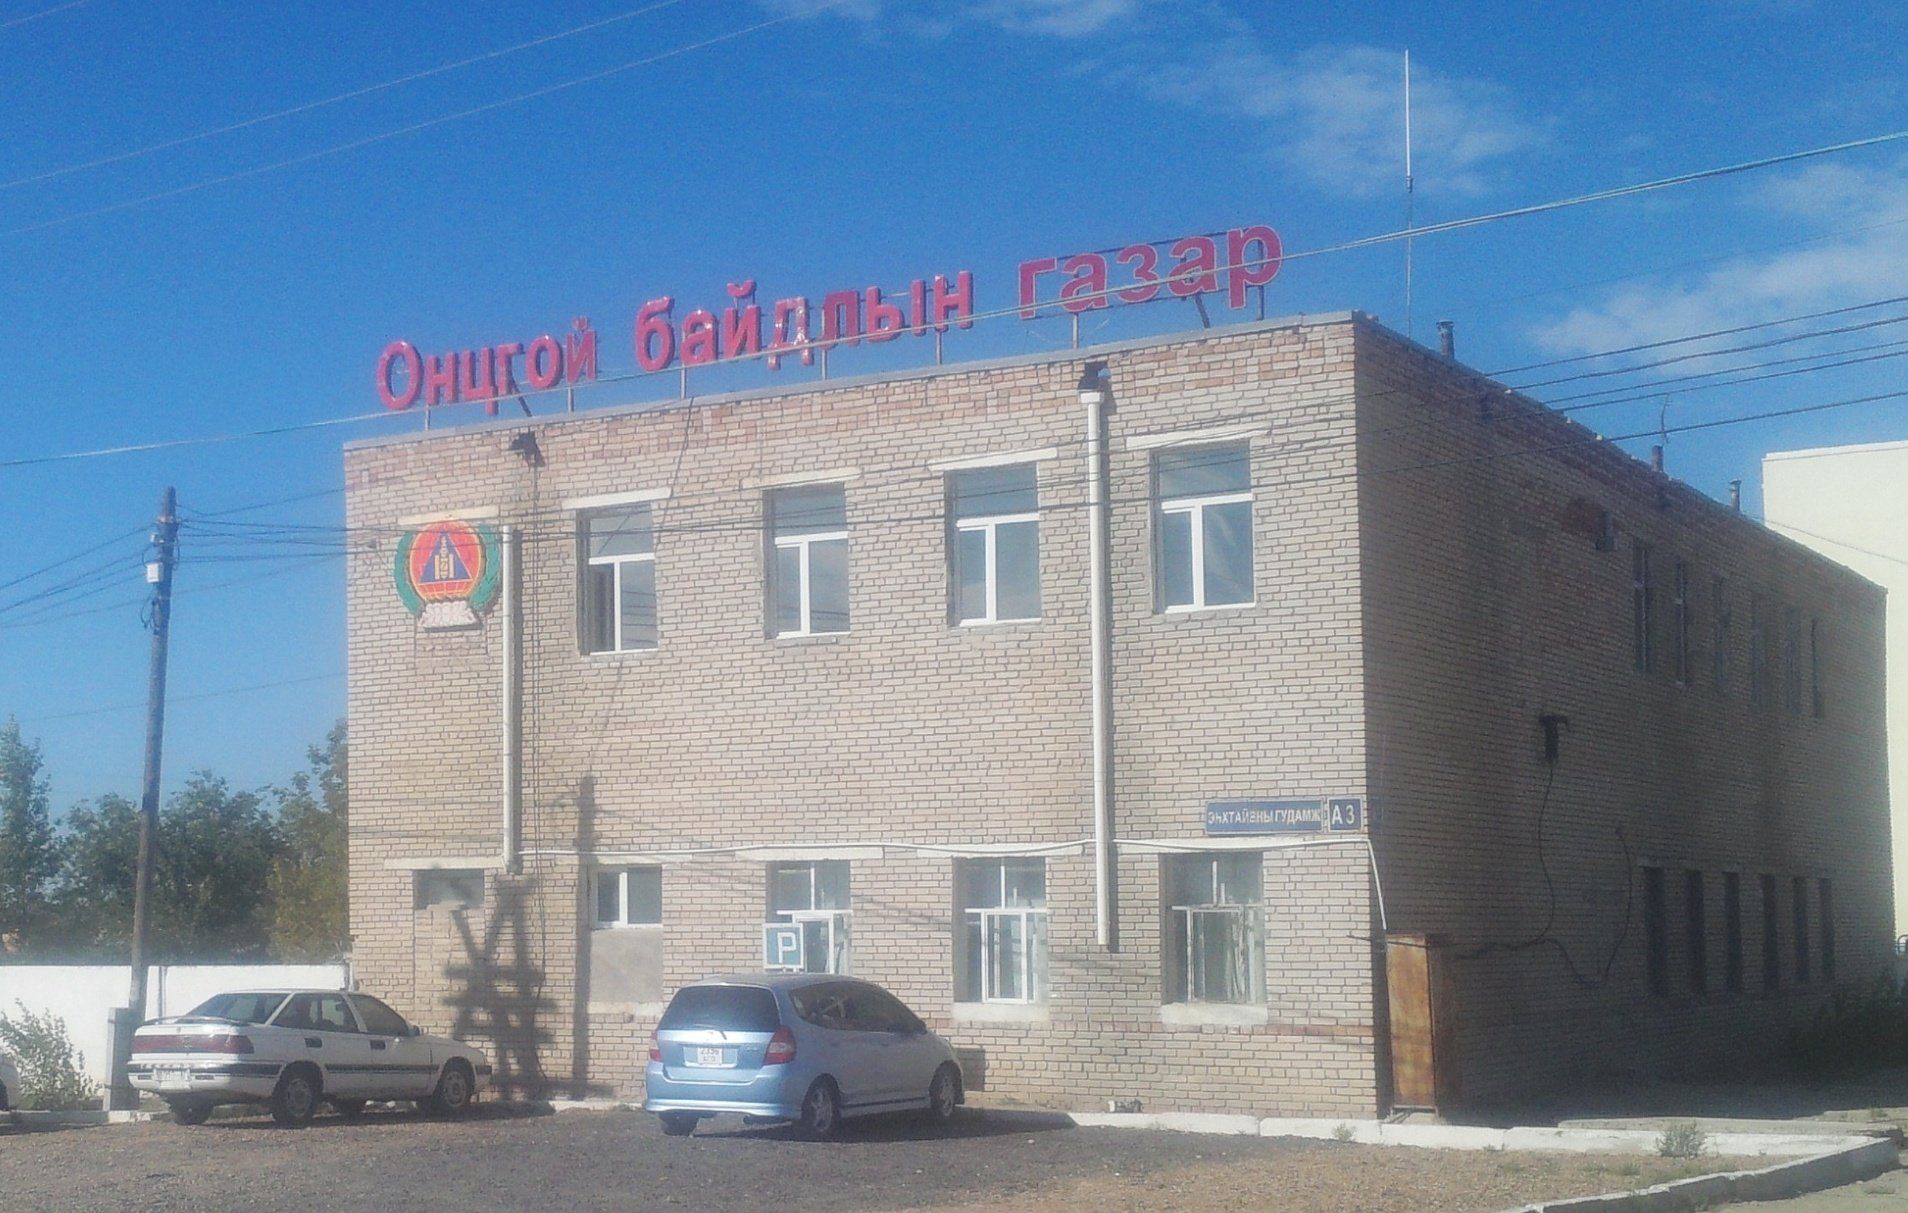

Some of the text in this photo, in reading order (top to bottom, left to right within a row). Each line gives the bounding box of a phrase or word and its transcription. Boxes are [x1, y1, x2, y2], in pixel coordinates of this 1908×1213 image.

[376, 224, 1284, 416] Онцгой байдлын газар
[776, 931, 797, 964] P
